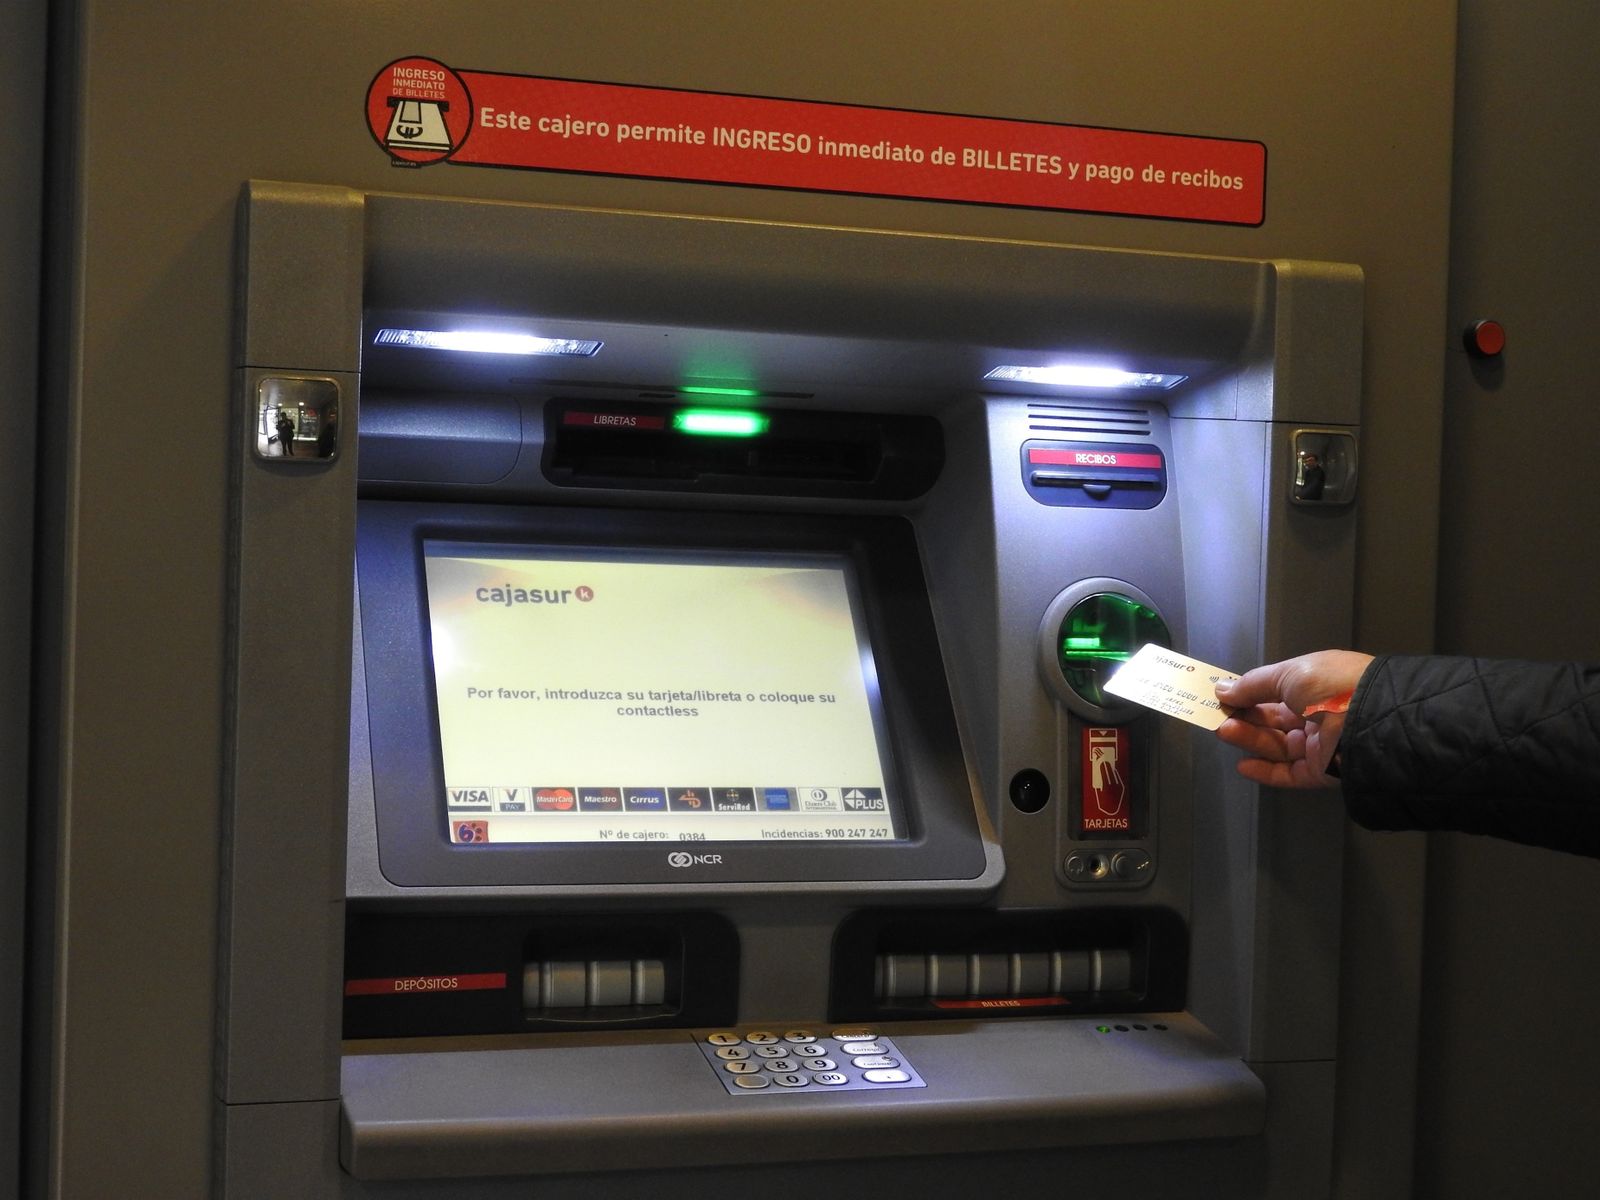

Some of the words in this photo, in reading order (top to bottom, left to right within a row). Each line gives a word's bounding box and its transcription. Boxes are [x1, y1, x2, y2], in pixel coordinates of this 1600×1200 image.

[393, 67, 445, 81] INGRESO
[393, 78, 445, 90] INMEDIATO
[392, 88, 403, 96] DE
[406, 89, 445, 99] BILLETES
[480, 107, 531, 130] Este
[538, 114, 610, 138] cajero
[617, 121, 706, 145] permite
[713, 127, 811, 154] INGRESO
[818, 136, 924, 164] inmediato
[930, 146, 955, 166] de
[963, 149, 1062, 175] BILLETES
[1068, 162, 1079, 181] y
[1085, 162, 1134, 184] pago
[1141, 164, 1165, 183] de
[1172, 168, 1244, 191] recibos
[594, 415, 637, 426] LIBRETAS
[1076, 453, 1116, 465] RECIBOS
[476, 584, 571, 607] cajasur
[467, 687, 493, 699] Por
[498, 687, 541, 701] favor,
[545, 688, 622, 700] introduzca
[627, 691, 644, 700] su
[649, 690, 741, 703] tarjeta/libreta
[746, 693, 755, 702] o
[759, 692, 815, 704] coloque
[819, 694, 836, 703] su
[617, 705, 699, 717] contactless
[451, 790, 489, 802] VISA
[503, 789, 518, 801] V
[537, 796, 573, 804] MasterCard
[630, 796, 660, 804] Cirrus
[718, 803, 750, 811] ServiRed
[856, 800, 884, 810] PLUS
[1084, 818, 1128, 829] TARJETAS
[617, 830, 629, 839] de
[632, 830, 669, 841] cajero:
[680, 833, 706, 841] 0384
[761, 829, 823, 838] Incidencias:
[825, 829, 844, 838] 900
[847, 829, 866, 838] 247
[870, 829, 888, 838] 247
[694, 854, 723, 864] NCR
[394, 977, 458, 991] DEPÓSITOS
[982, 1000, 1020, 1008] BILLETES
[793, 1032, 806, 1040] 3
[766, 1047, 778, 1055] 5
[804, 1046, 816, 1054] 6
[735, 1062, 746, 1071] 7
[775, 1061, 788, 1069] 8
[814, 1060, 827, 1068] 9
[785, 1075, 799, 1083] 0
